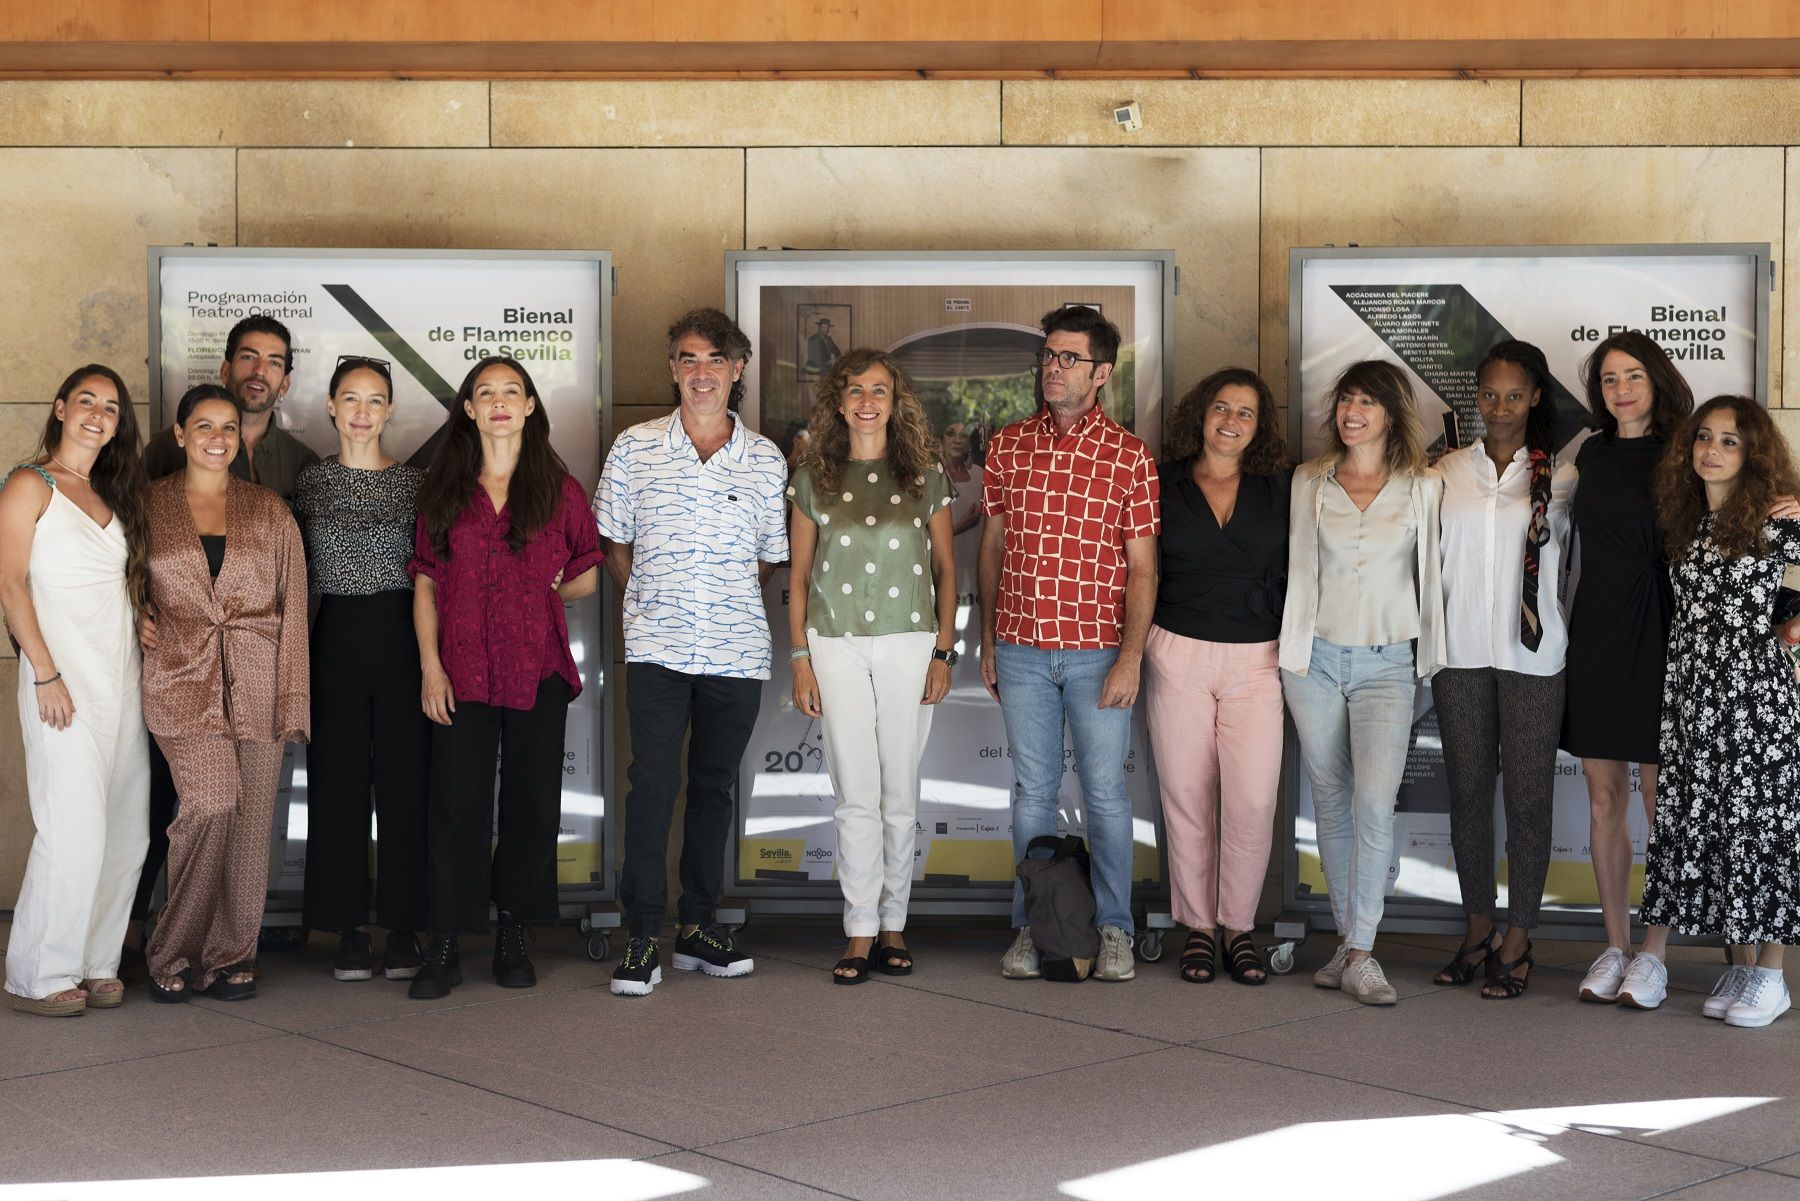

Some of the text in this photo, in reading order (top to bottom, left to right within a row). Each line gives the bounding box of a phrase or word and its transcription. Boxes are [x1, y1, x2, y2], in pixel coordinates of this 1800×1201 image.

[188, 290, 308, 306] Programación
[187, 305, 313, 319] Teatro Central
[503, 307, 573, 324] Bienal
[1651, 304, 1727, 322] Bienal
[428, 326, 573, 342] de Flamenco
[1570, 325, 1600, 341] de
[464, 344, 573, 361] de Sevilla
[1662, 342, 1726, 361] evilla
[979, 746, 1002, 759] del
